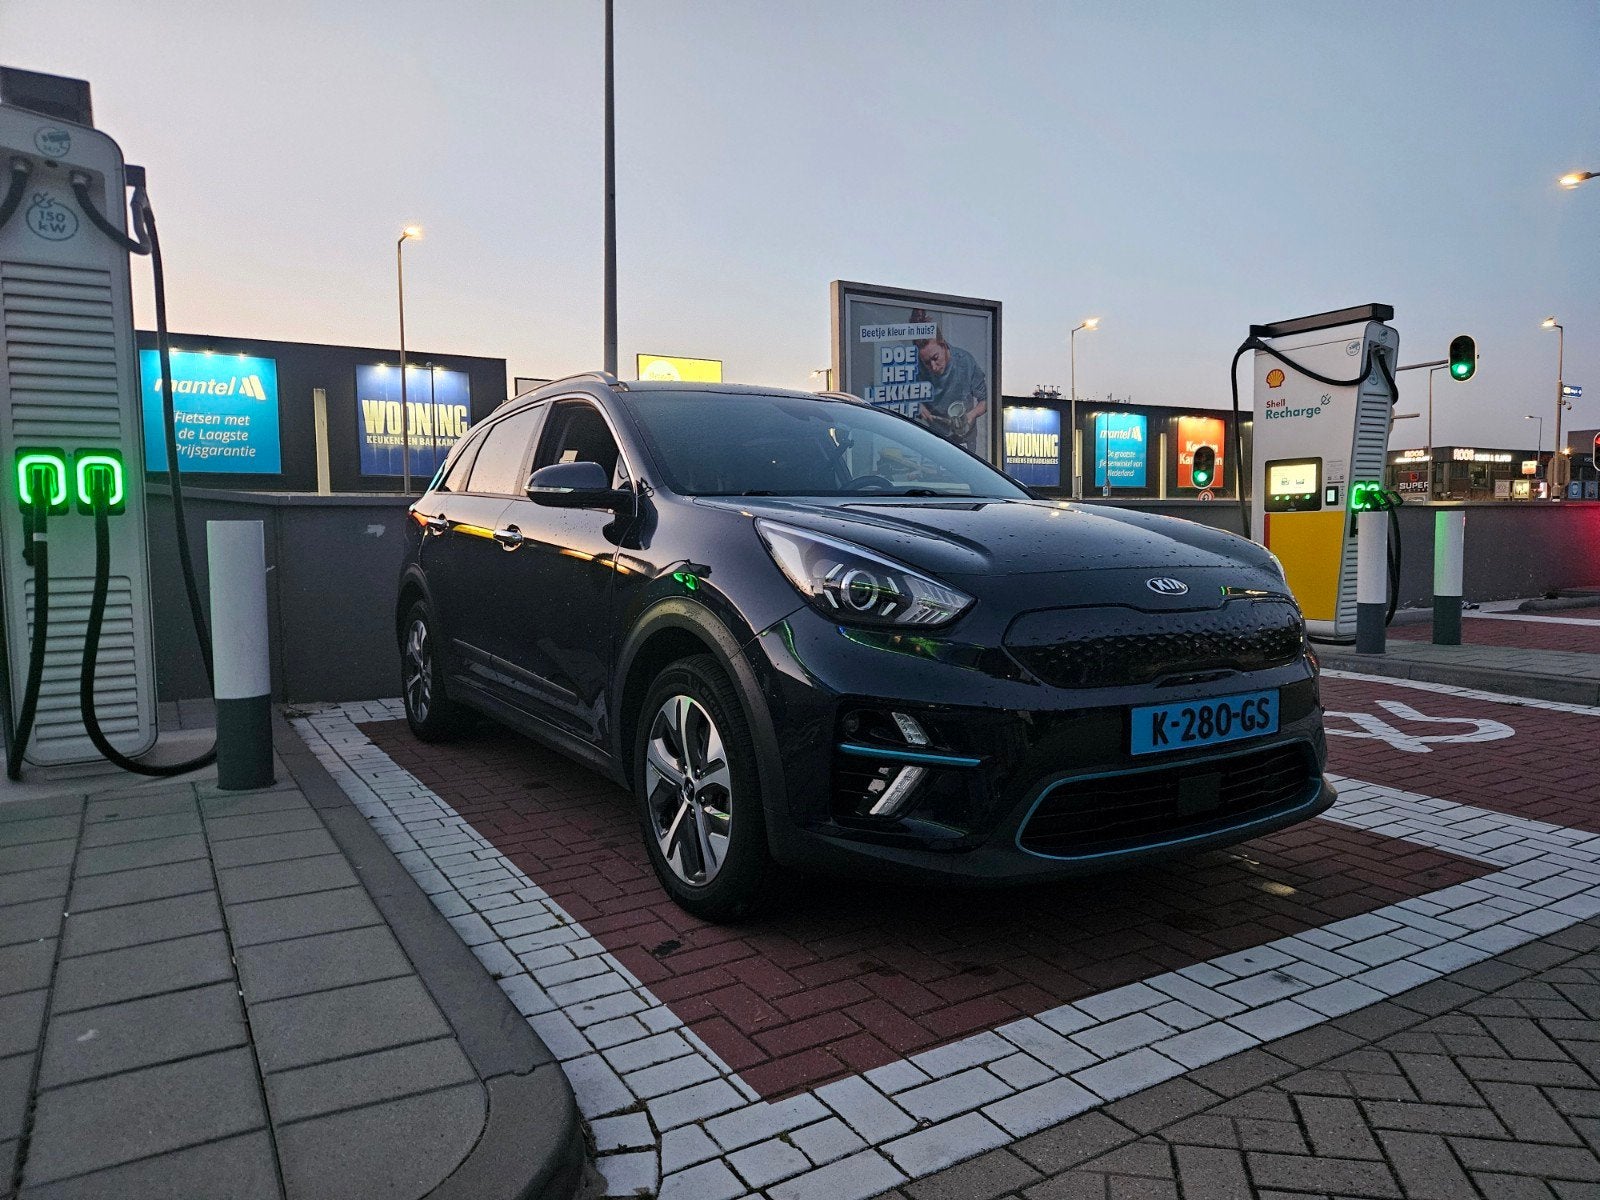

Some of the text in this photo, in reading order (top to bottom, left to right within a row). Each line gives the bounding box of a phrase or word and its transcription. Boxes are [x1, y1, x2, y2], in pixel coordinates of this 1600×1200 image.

[39, 210, 66, 222] 150
[38, 221, 66, 234] kW
[861, 325, 935, 339] Beetje kleur in huis?
[881, 346, 917, 364] DOE
[881, 366, 917, 383] HET
[154, 376, 237, 396] mantel
[864, 383, 932, 403] LEKKER
[1266, 398, 1286, 408] Shell
[175, 411, 251, 426] Fietsen met
[361, 399, 469, 438] WOONING
[1265, 406, 1321, 420] Recharge
[178, 428, 249, 443] de Laagste
[366, 435, 405, 445] KEUKENS
[1005, 432, 1059, 458] WOONING
[1150, 578, 1187, 592] KIA
[1151, 697, 1271, 746] K-280-GS
